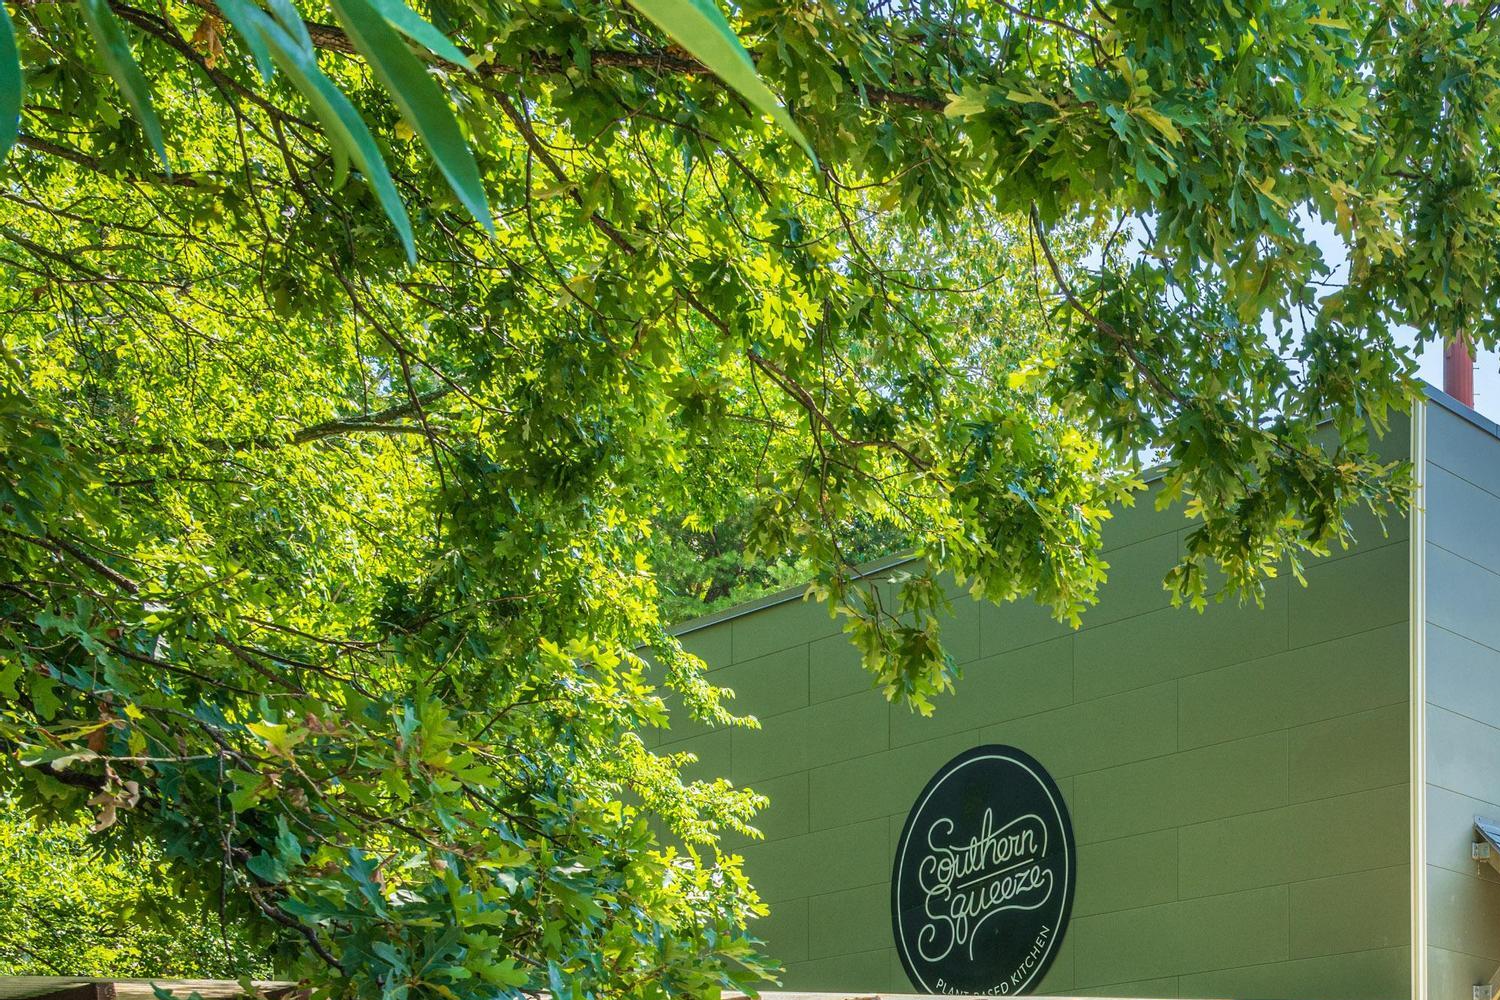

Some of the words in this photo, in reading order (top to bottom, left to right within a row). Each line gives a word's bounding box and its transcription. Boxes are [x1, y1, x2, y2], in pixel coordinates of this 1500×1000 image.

[918, 807, 1048, 895] Southern
[918, 865, 1054, 962] Squeeze
[1010, 924, 1051, 986] KITCHEN
